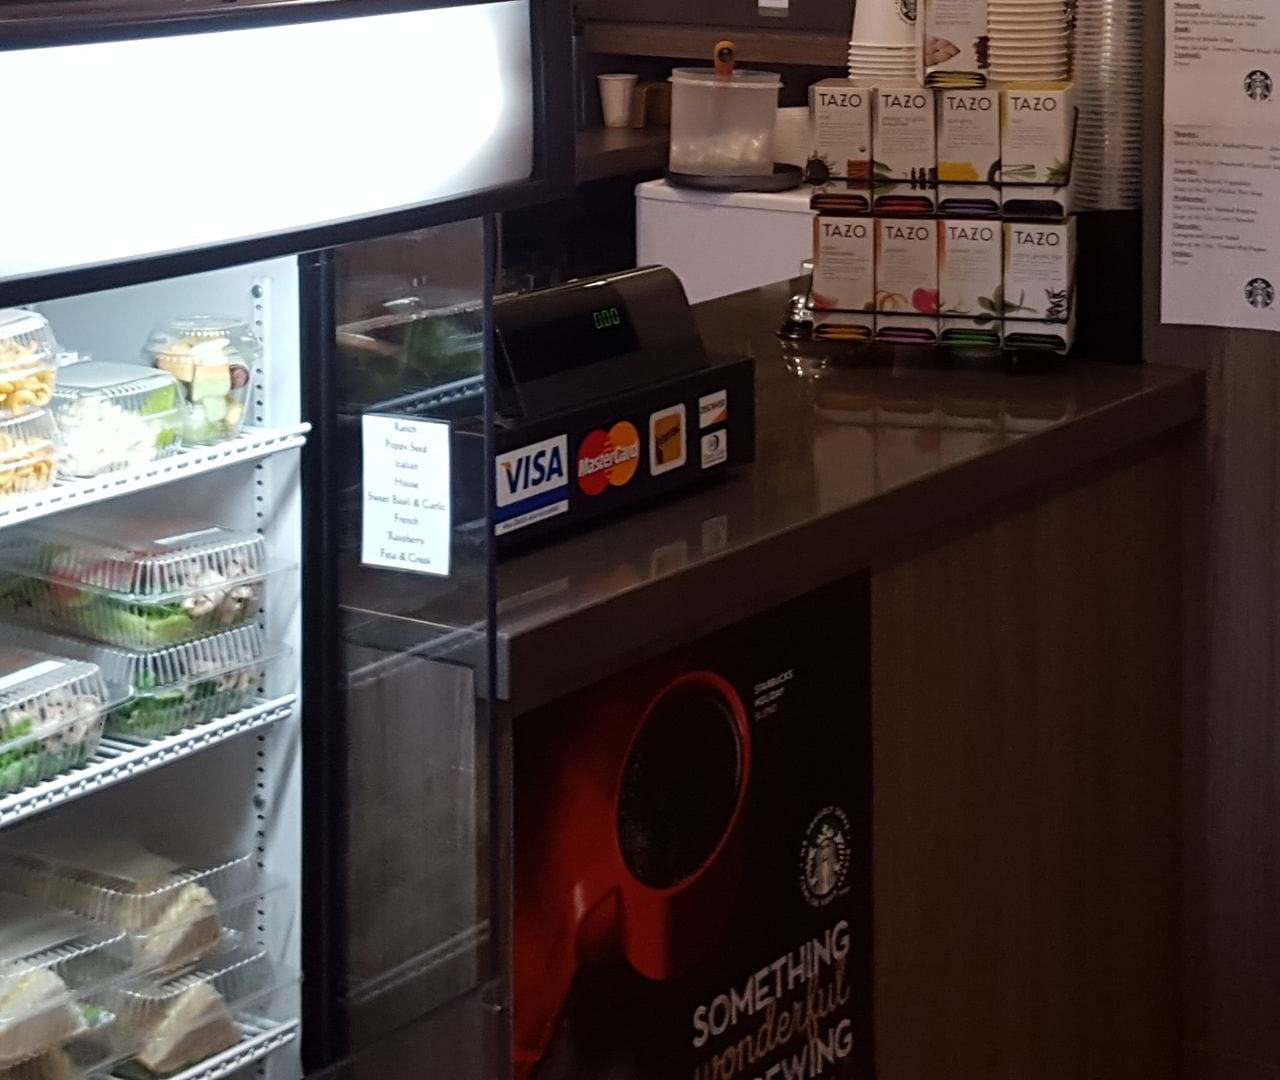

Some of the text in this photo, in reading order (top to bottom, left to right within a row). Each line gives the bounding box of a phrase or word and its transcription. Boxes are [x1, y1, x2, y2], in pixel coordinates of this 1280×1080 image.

[819, 93, 1057, 112] TAZO TAZO TAZO TAZO
[823, 223, 1061, 247] TAZO TAZO TAZO TAZO
[500, 446, 564, 494] VISA
[577, 443, 640, 478] MasterCard
[692, 920, 852, 1048] SOMETHING
